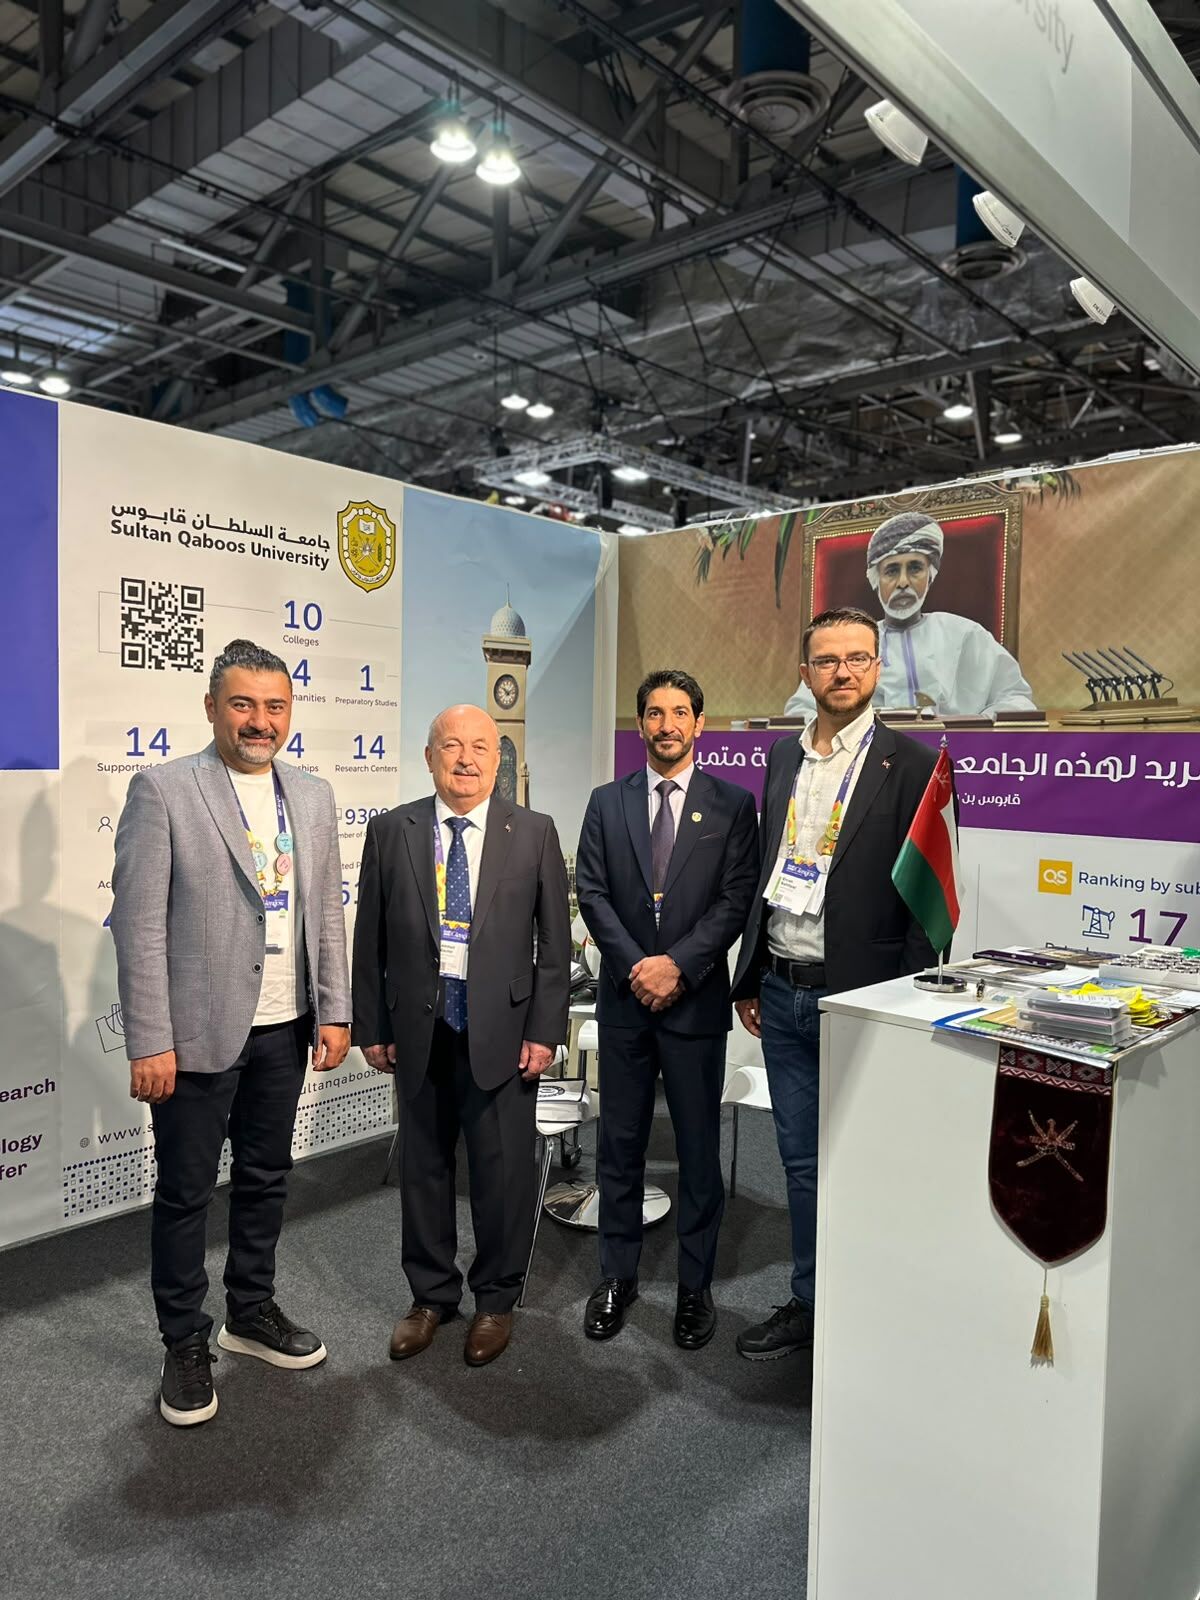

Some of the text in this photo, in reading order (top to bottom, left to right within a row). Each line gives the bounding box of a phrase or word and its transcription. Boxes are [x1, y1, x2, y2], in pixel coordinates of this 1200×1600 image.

[111, 504, 330, 552] جامعة السلطان قابوس
[111, 519, 330, 571] Sultan Qaboos University
[284, 600, 322, 631] 10
[282, 634, 320, 647] Colleges
[292, 658, 311, 687] 4
[360, 665, 375, 692] 1
[335, 696, 398, 708] Preparatory Studies
[126, 727, 171, 757] 14
[286, 732, 305, 759] 4
[353, 734, 386, 760] 14
[97, 762, 153, 774] Supported
[335, 764, 398, 773] Research Centers
[1054, 751, 1137, 783] لهذه
[978, 793, 1021, 807] قابوس
[345, 807, 389, 825] 930
[1043, 869, 1067, 886] QS
[1079, 872, 1145, 892] Ranking
[1151, 878, 1171, 895] by
[1129, 908, 1188, 946] 17
[0, 1078, 56, 1102] earch
